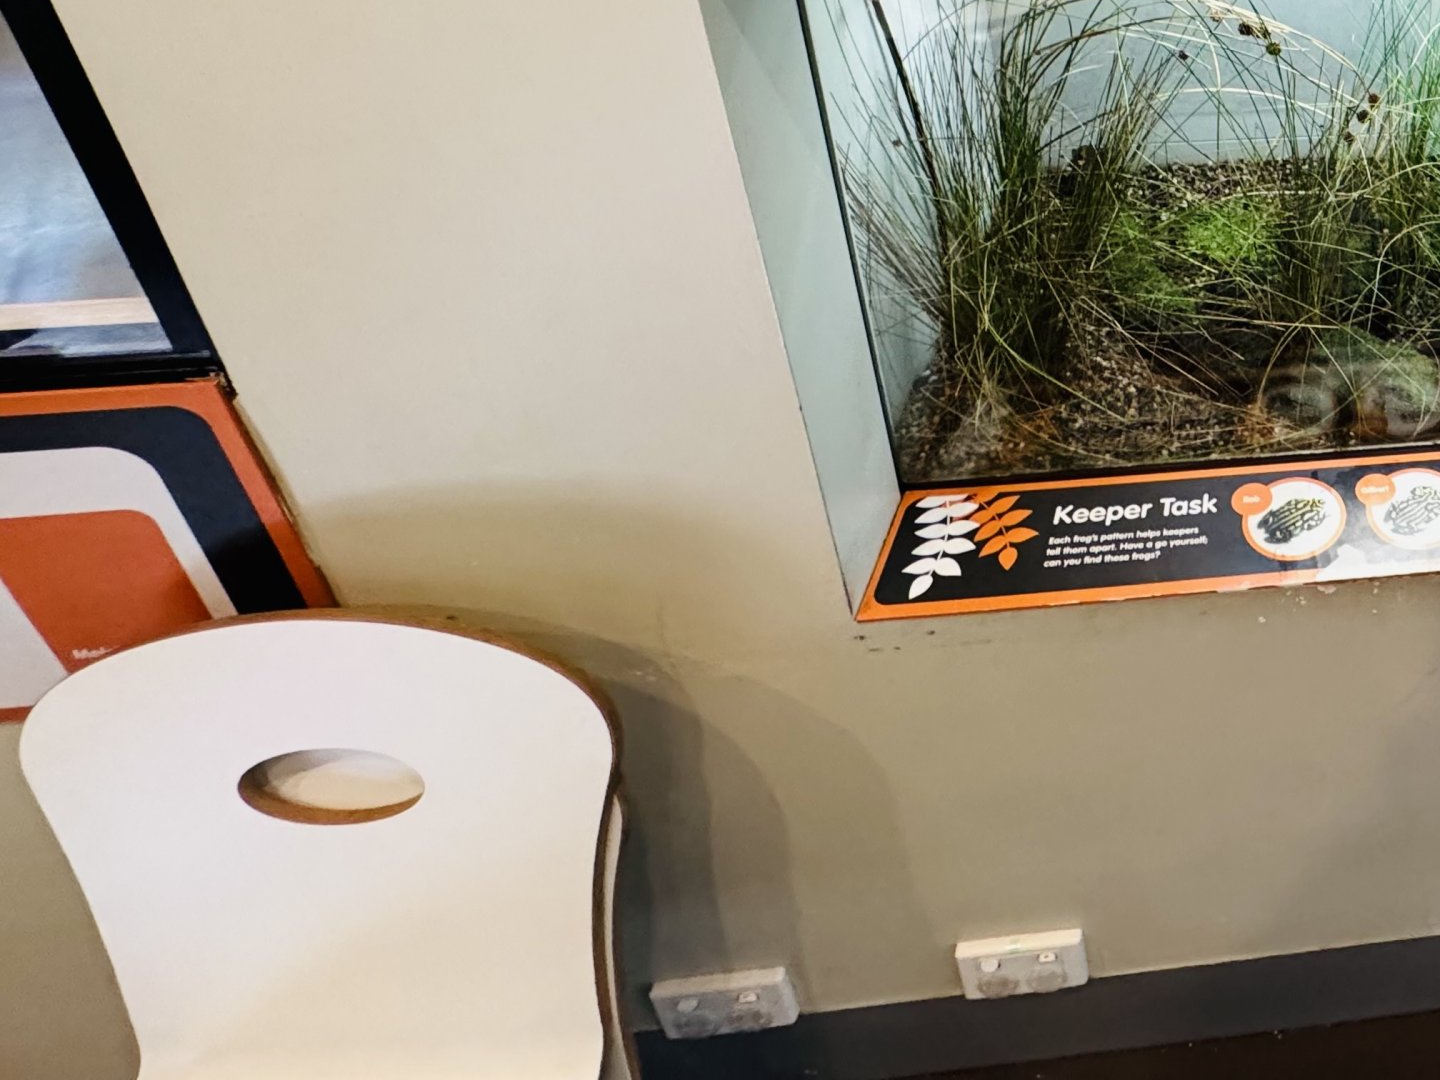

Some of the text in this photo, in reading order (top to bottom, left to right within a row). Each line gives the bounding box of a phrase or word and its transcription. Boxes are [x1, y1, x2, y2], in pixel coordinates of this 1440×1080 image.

[1053, 493, 1218, 526] Keeper Task
[1048, 535, 1072, 545] Each
[1100, 532, 1134, 543] pattern
[1136, 529, 1161, 539] helps
[1162, 527, 1199, 537] keepers
[1046, 546, 1061, 556] tell
[1063, 546, 1087, 555] them
[1089, 543, 1117, 554] apart.
[1119, 542, 1144, 551] Have
[1155, 540, 1168, 550] go
[1043, 550, 1161, 568] can you find these frogs?
